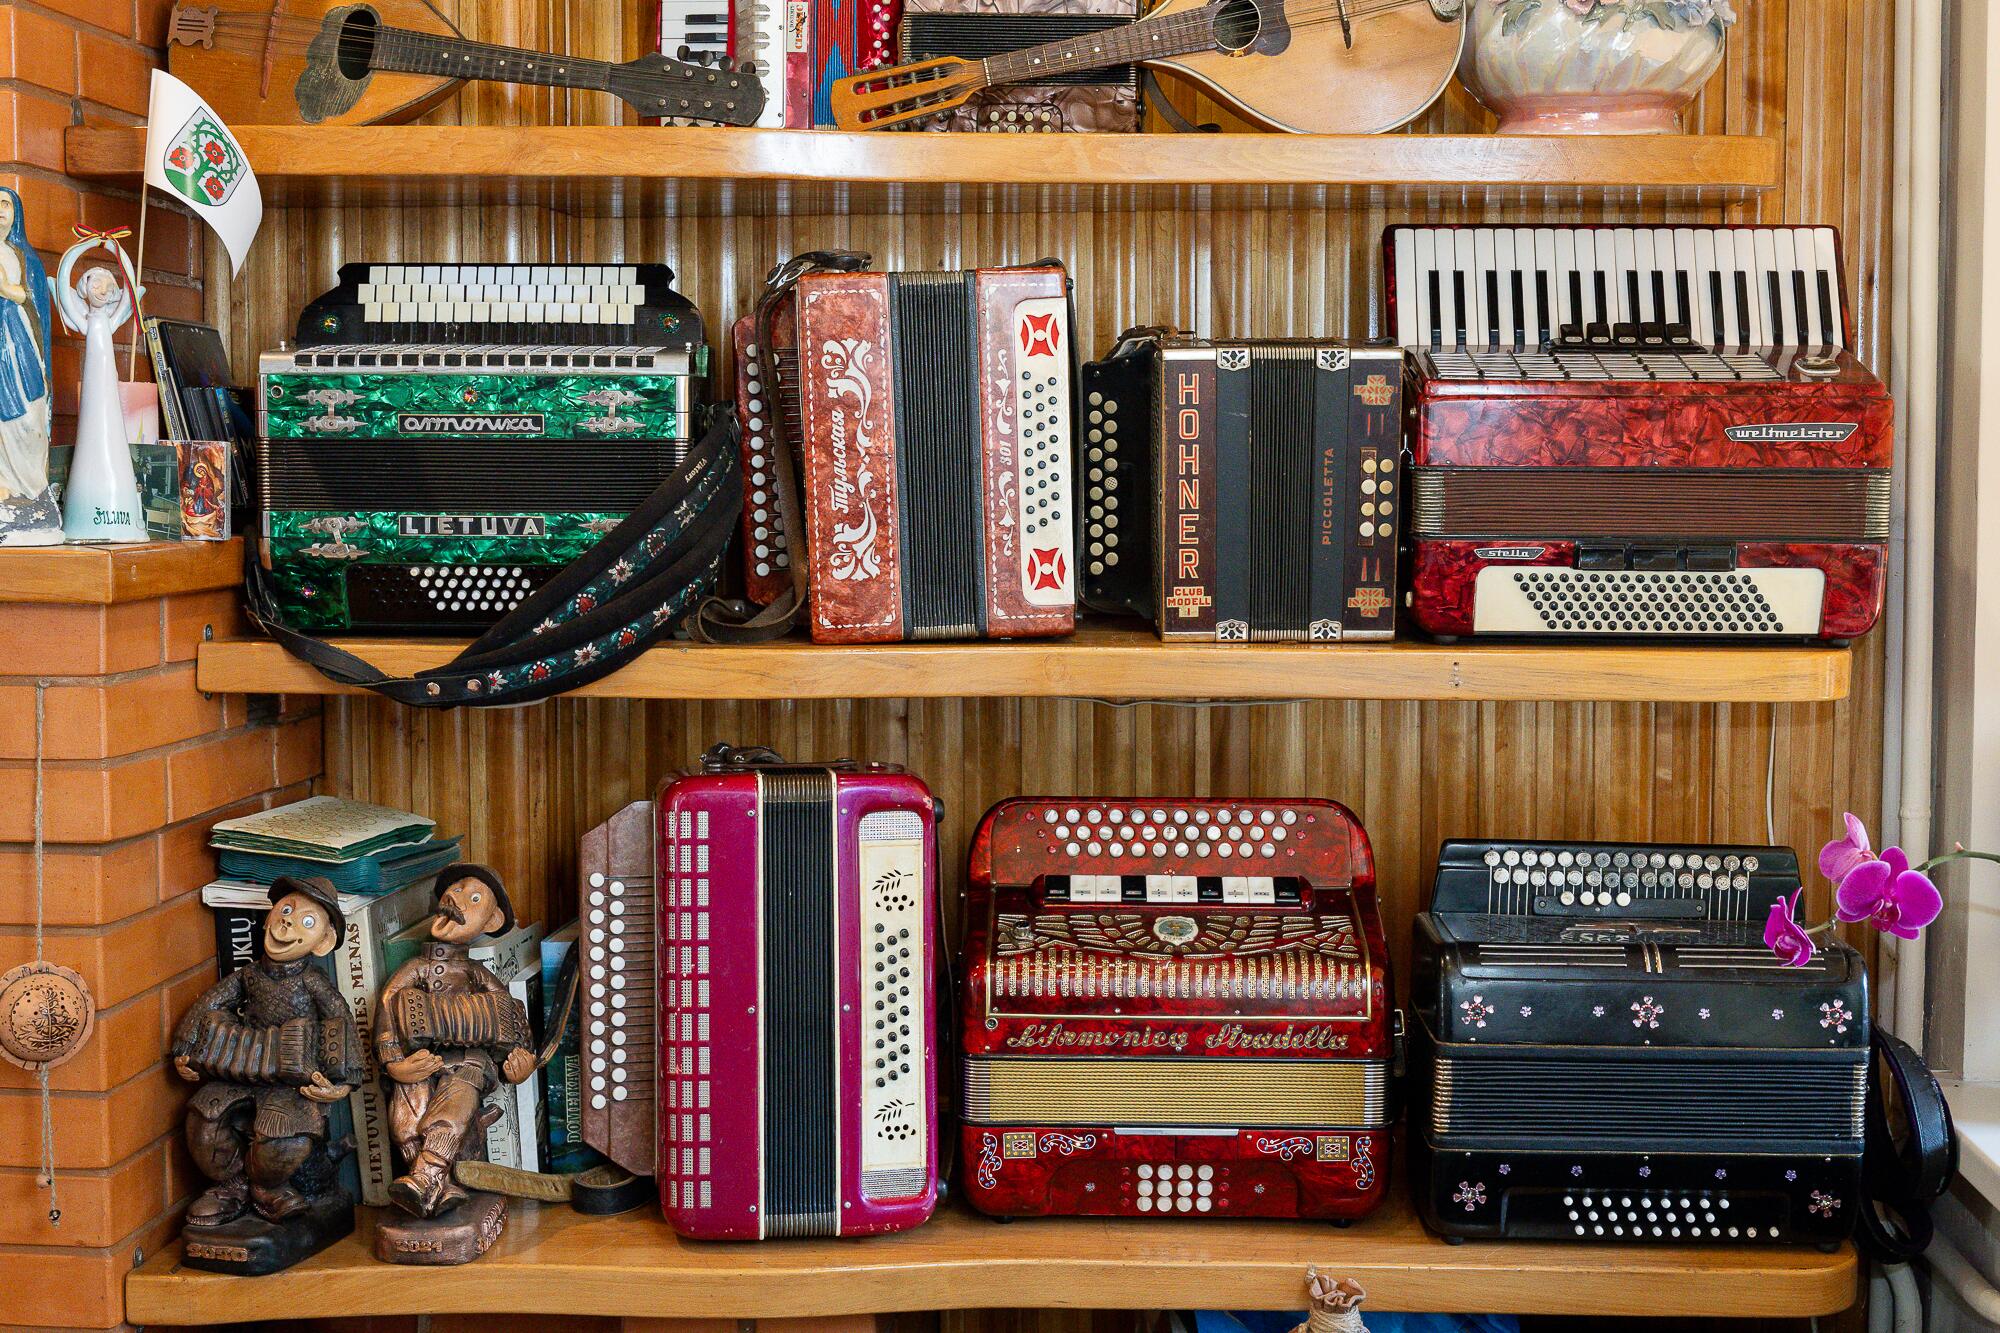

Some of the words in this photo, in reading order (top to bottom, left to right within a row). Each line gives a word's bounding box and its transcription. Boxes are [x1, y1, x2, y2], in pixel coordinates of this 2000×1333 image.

[1735, 427, 1845, 438] weltmeister
[828, 409, 855, 514] Тульская
[1178, 373, 1200, 579] HOHNER
[1321, 447, 1335, 546] PICCOLETTA
[406, 516, 540, 535] LIETUVA
[1487, 549, 1530, 558] stella
[1167, 597, 1211, 606] MODELL
[1174, 588, 1203, 596] CLUB
[345, 922, 365, 990] MENAS
[1006, 1023, 1189, 1048] L'Armonica
[1205, 1023, 1349, 1049] Stradella
[565, 1055, 582, 1143] DOMEIKAVA
[364, 1089, 384, 1186] LIETUVIŲ
